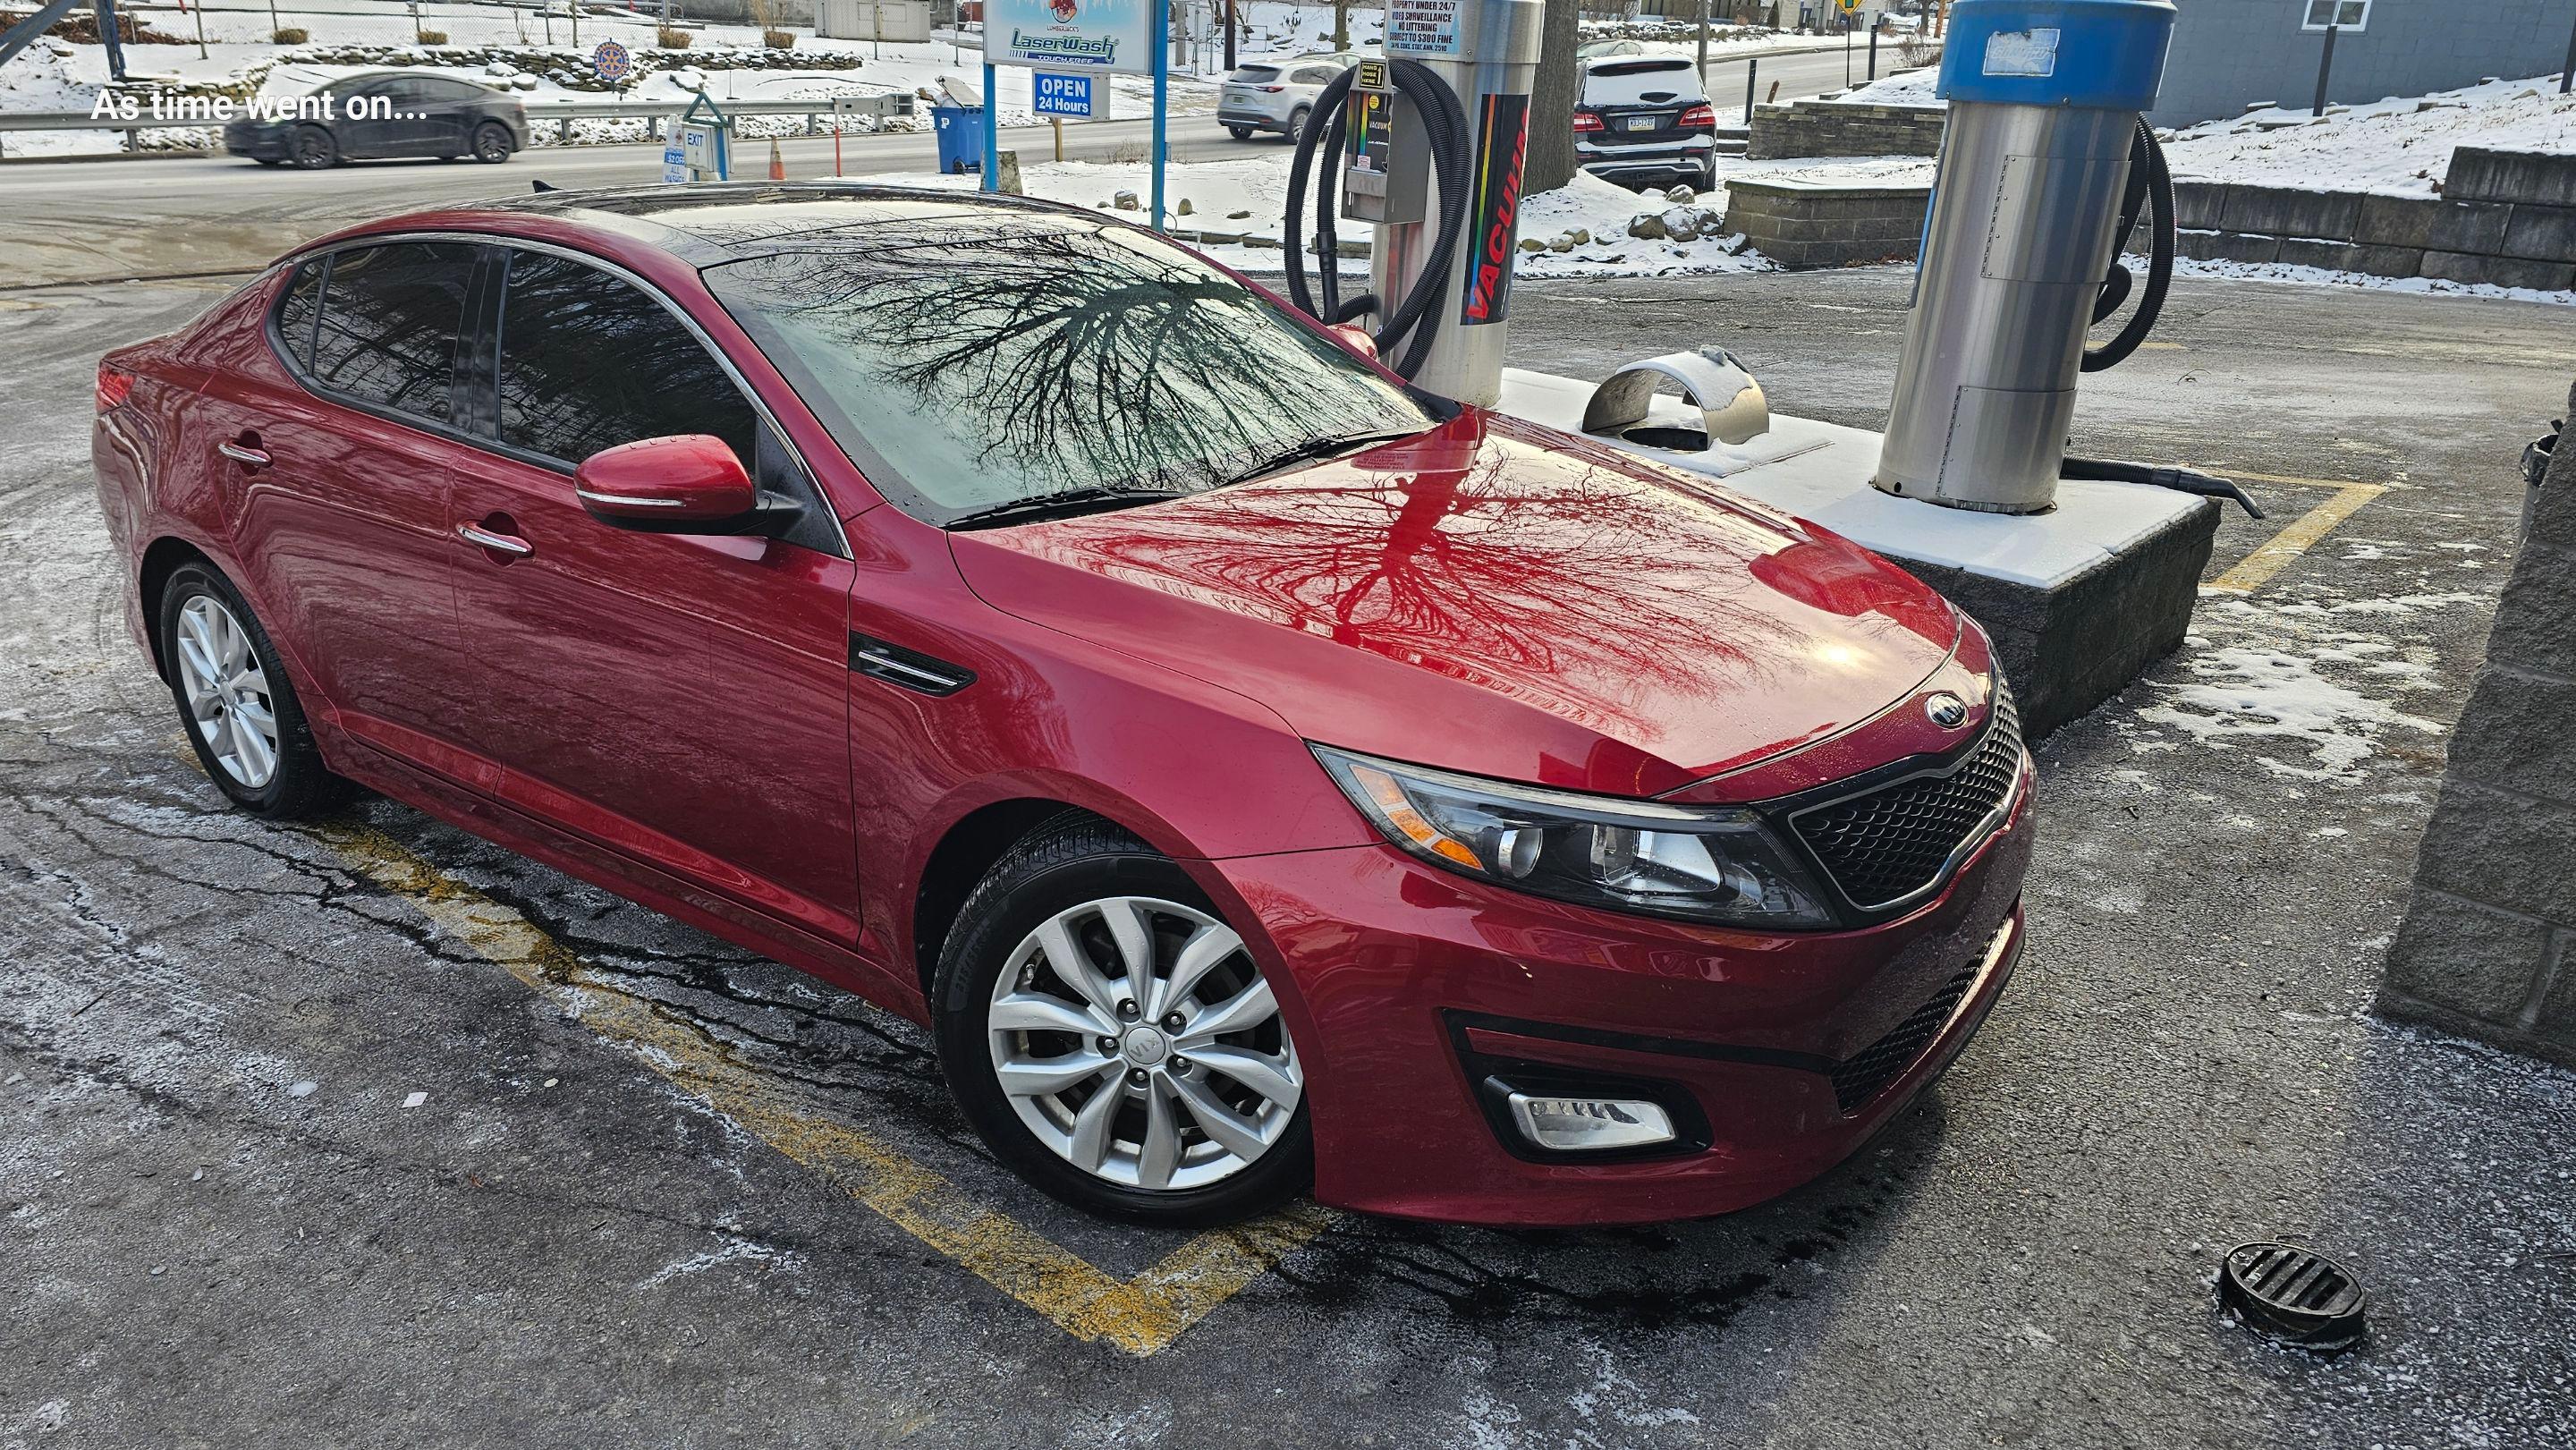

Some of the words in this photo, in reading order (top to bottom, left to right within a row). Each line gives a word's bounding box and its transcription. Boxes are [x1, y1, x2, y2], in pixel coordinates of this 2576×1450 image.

[1416, 1, 1436, 10] UNDER
[1438, 2, 1455, 11] 24/7
[1392, 12, 1404, 20] VIDEO
[1405, 13, 1452, 22] SURVEILLANCE
[1398, 22, 1405, 30] NO
[1406, 22, 1437, 32] LITTERING
[1389, 32, 1408, 40] SUBJECT
[1409, 32, 1416, 42] TO
[1418, 33, 1436, 43] $300
[1437, 35, 1453, 44] FINE
[1041, 78, 1086, 98] OPEN
[1038, 96, 1053, 110] 24
[1055, 98, 1089, 114] Hours
[688, 133, 703, 146] EXIT
